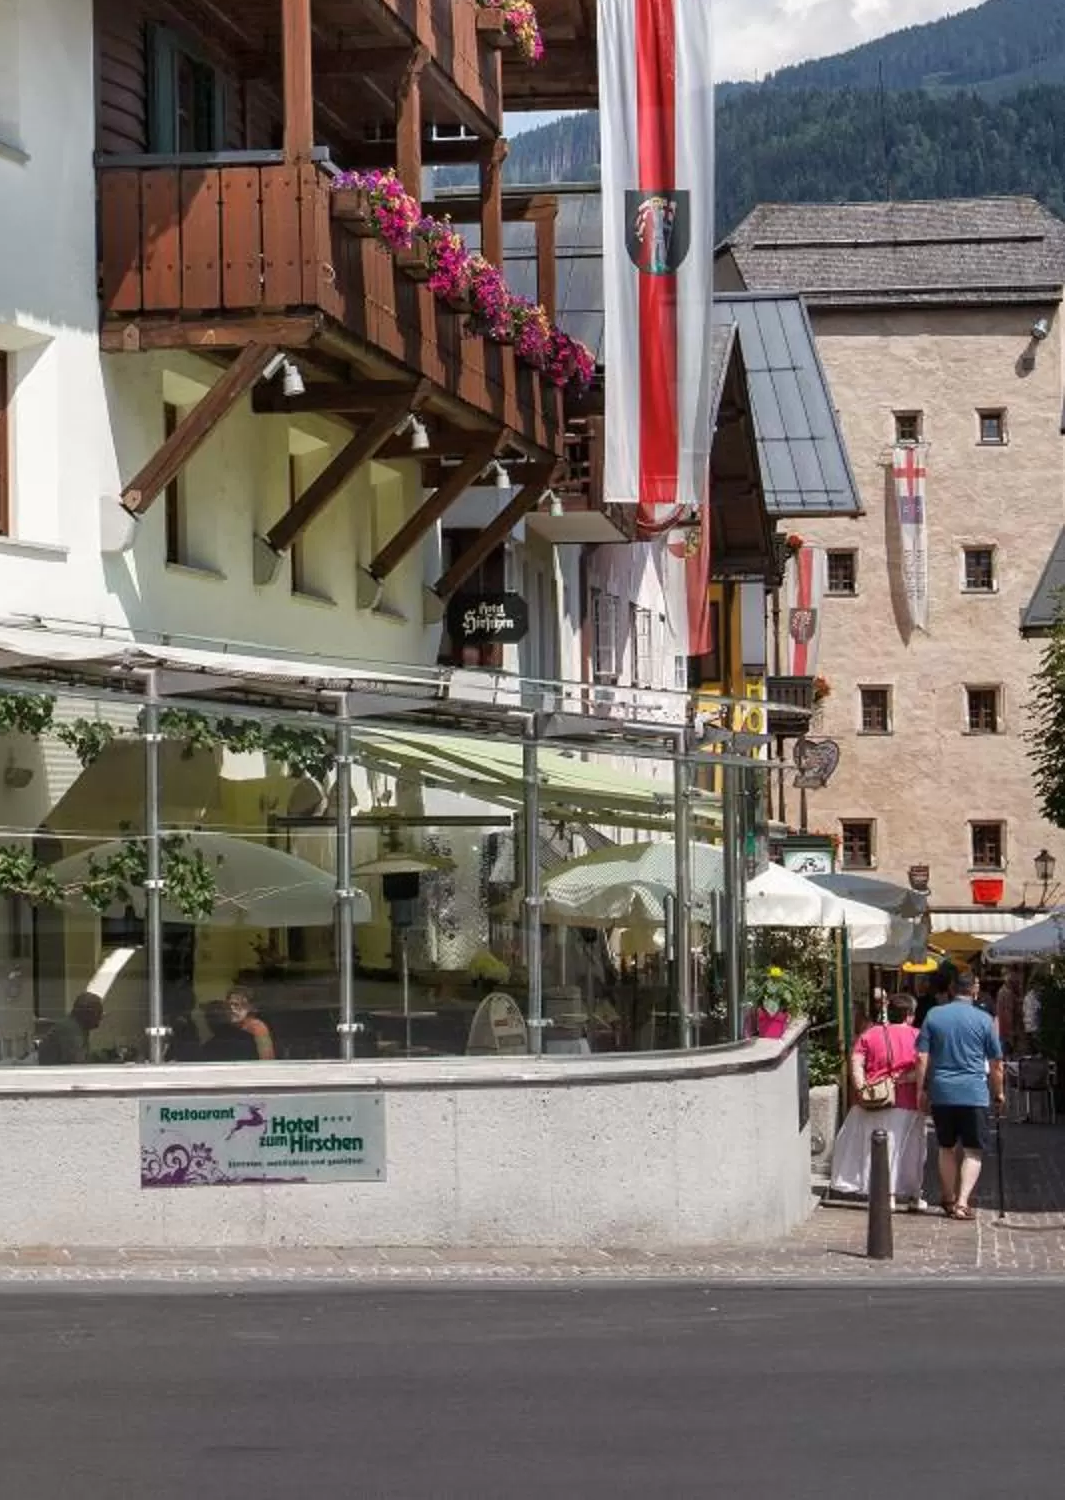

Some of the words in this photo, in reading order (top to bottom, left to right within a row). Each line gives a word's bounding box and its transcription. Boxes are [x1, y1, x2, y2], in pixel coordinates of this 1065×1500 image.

[160, 1106, 235, 1123] Restaurant
[272, 1116, 320, 1134] Hotel
[259, 1135, 288, 1148] zum
[289, 1133, 364, 1154] Hirschen
